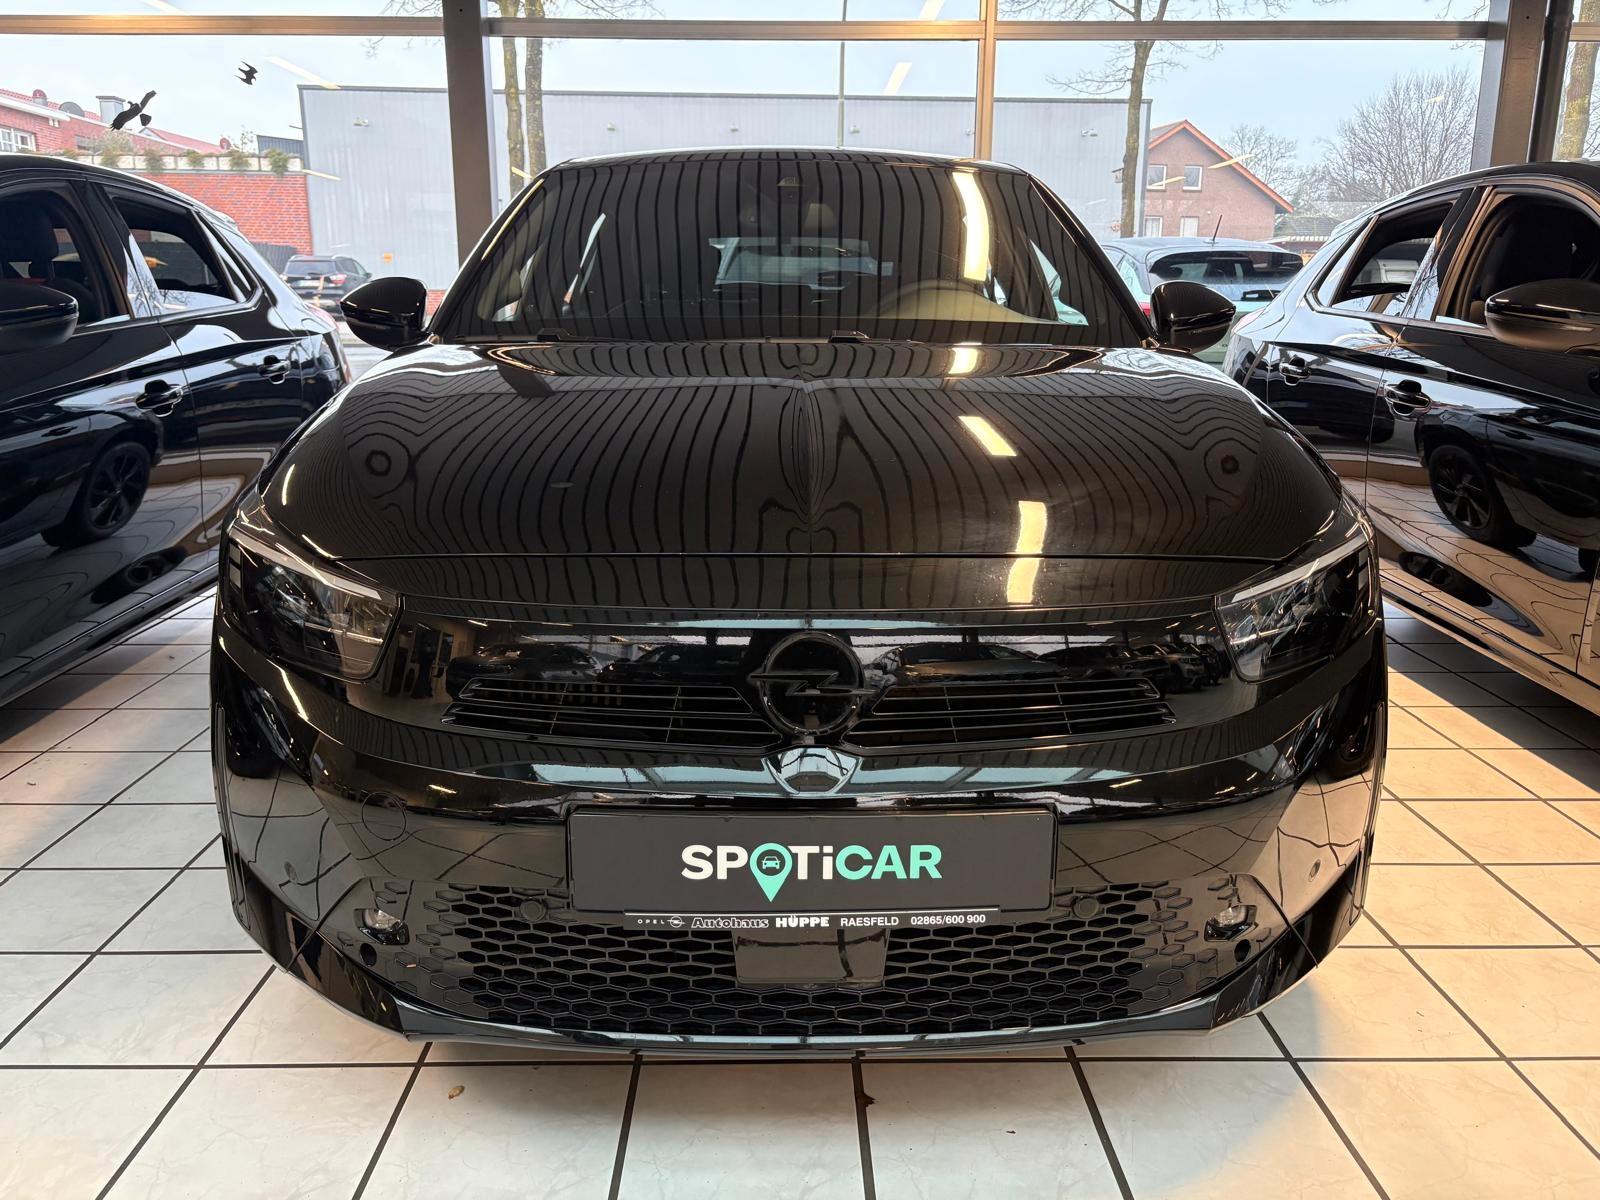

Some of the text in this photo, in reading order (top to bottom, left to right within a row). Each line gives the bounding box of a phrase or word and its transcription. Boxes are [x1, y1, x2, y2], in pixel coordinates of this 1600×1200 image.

[691, 917, 769, 929] Autohaus
[775, 915, 830, 928] HÜPPE
[840, 916, 899, 927] RAESFELD
[910, 915, 965, 926] 02865/600
[966, 914, 986, 924] 900
